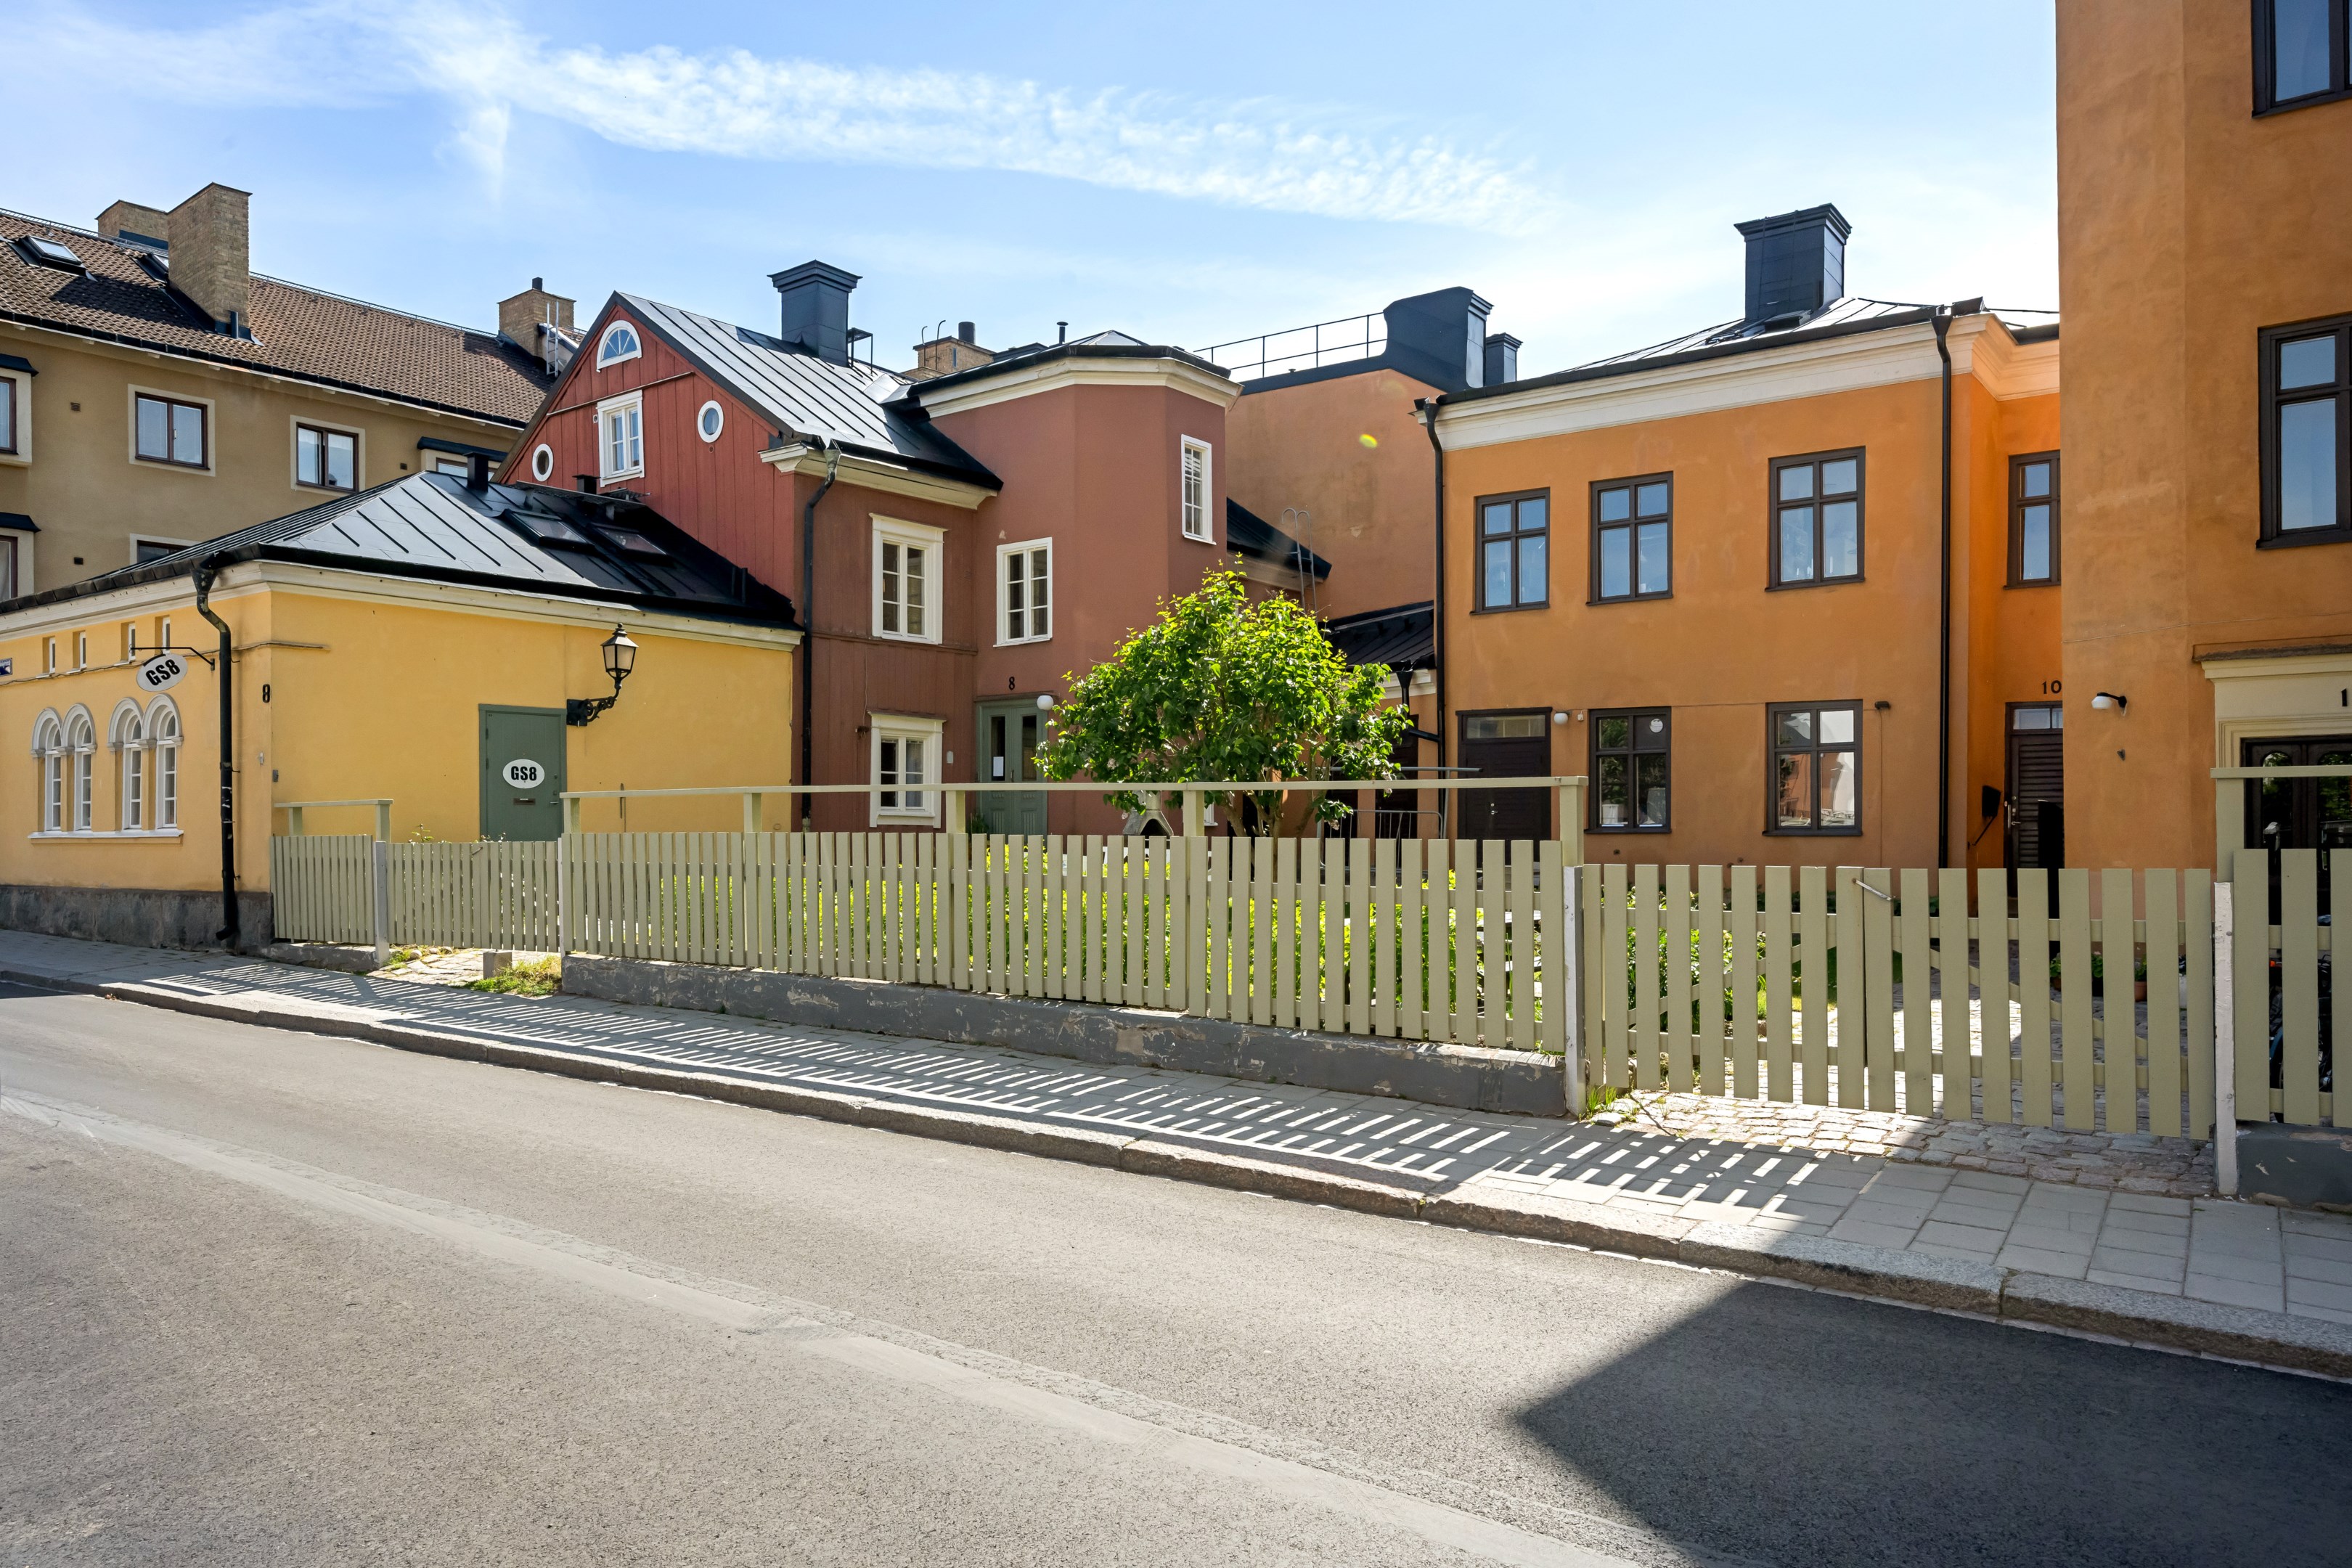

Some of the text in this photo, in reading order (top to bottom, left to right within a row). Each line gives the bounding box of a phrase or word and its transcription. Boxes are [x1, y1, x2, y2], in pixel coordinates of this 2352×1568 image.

[146, 659, 180, 685] GS8
[1009, 677, 1015, 690] 8
[2041, 680, 2062, 694] 10
[263, 684, 270, 703] 8
[511, 766, 536, 781] GS8
